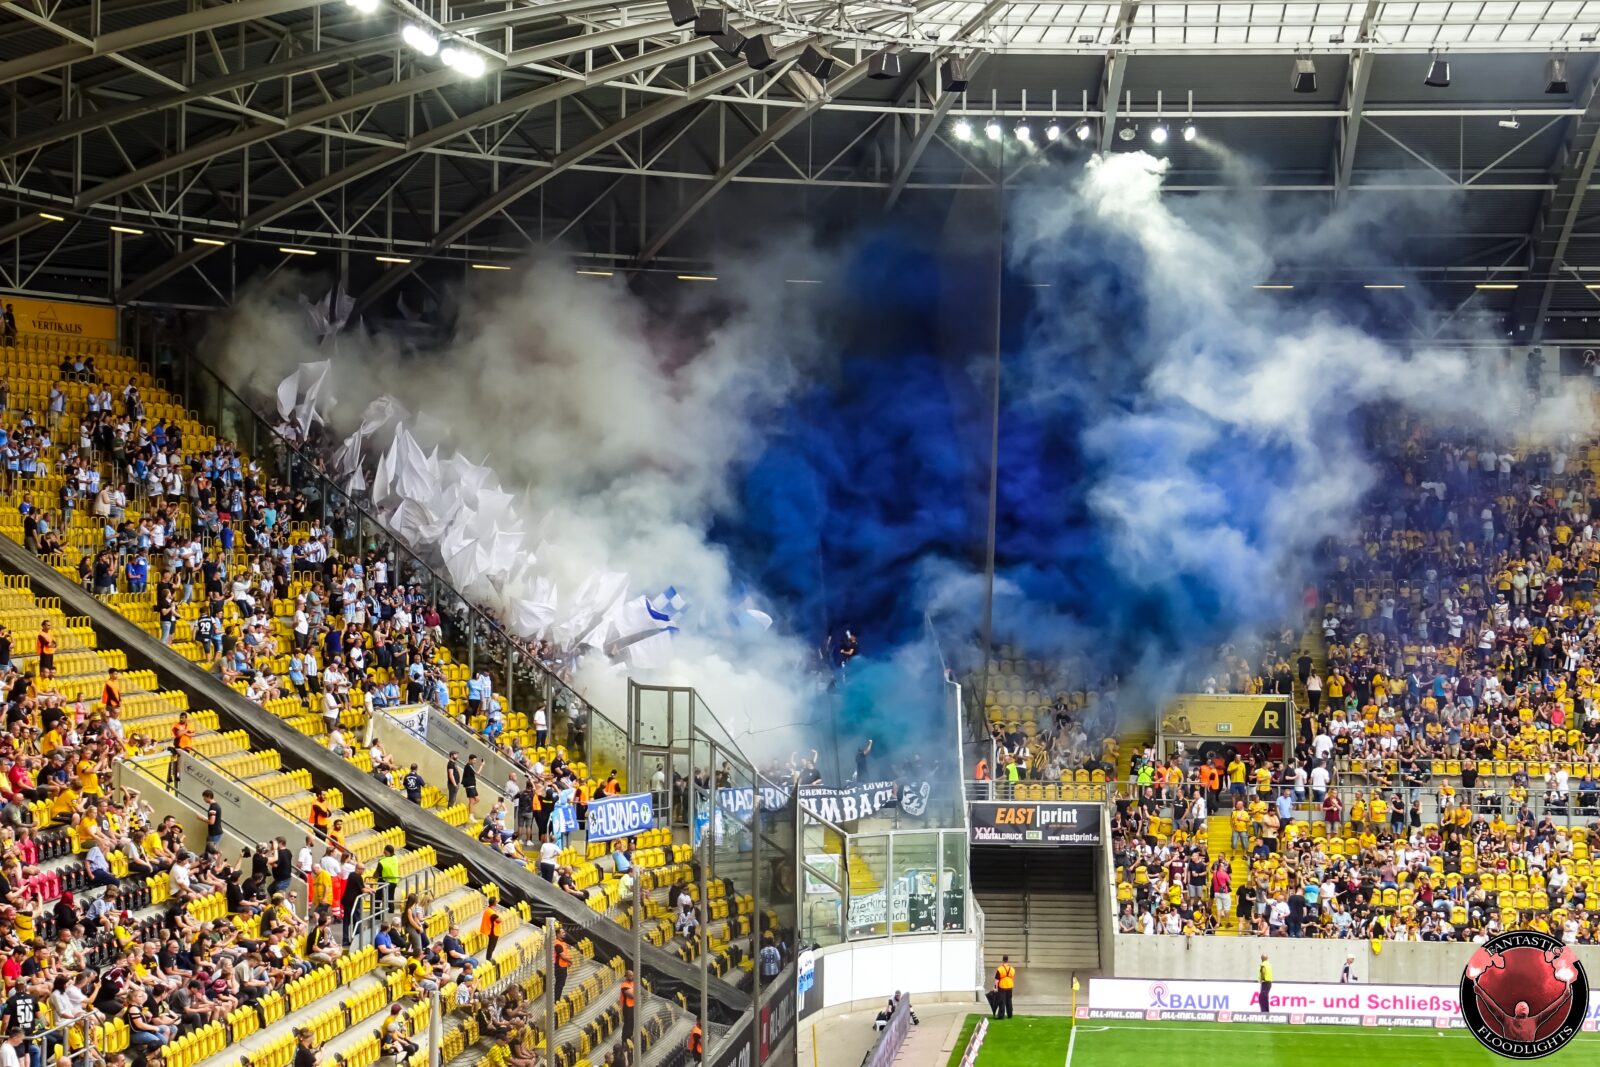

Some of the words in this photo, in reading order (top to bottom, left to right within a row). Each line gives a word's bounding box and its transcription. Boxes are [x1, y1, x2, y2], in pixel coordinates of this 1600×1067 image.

[32, 320, 82, 334] VERTIKALIS
[200, 622, 211, 632] 29
[1264, 710, 1280, 729] R
[597, 800, 640, 836] AUBING
[995, 807, 1035, 825] EAST
[1041, 808, 1078, 825] print
[1047, 832, 1100, 842] www.eastprint.de
[1170, 994, 1229, 1009] BAUM
[1249, 991, 1315, 1007] Aarm-
[1323, 994, 1359, 1009] und
[16, 1004, 34, 1023] 50
[1089, 1010, 1143, 1020] ALL-INKL.COM
[1161, 1011, 1214, 1021] ALL-INKL.COM
[1233, 1013, 1287, 1023] ALL-INKL.COM
[1305, 1015, 1360, 1025] ALL-INKL.COM
[1378, 1017, 1432, 1027] ALL-INKL.COM
